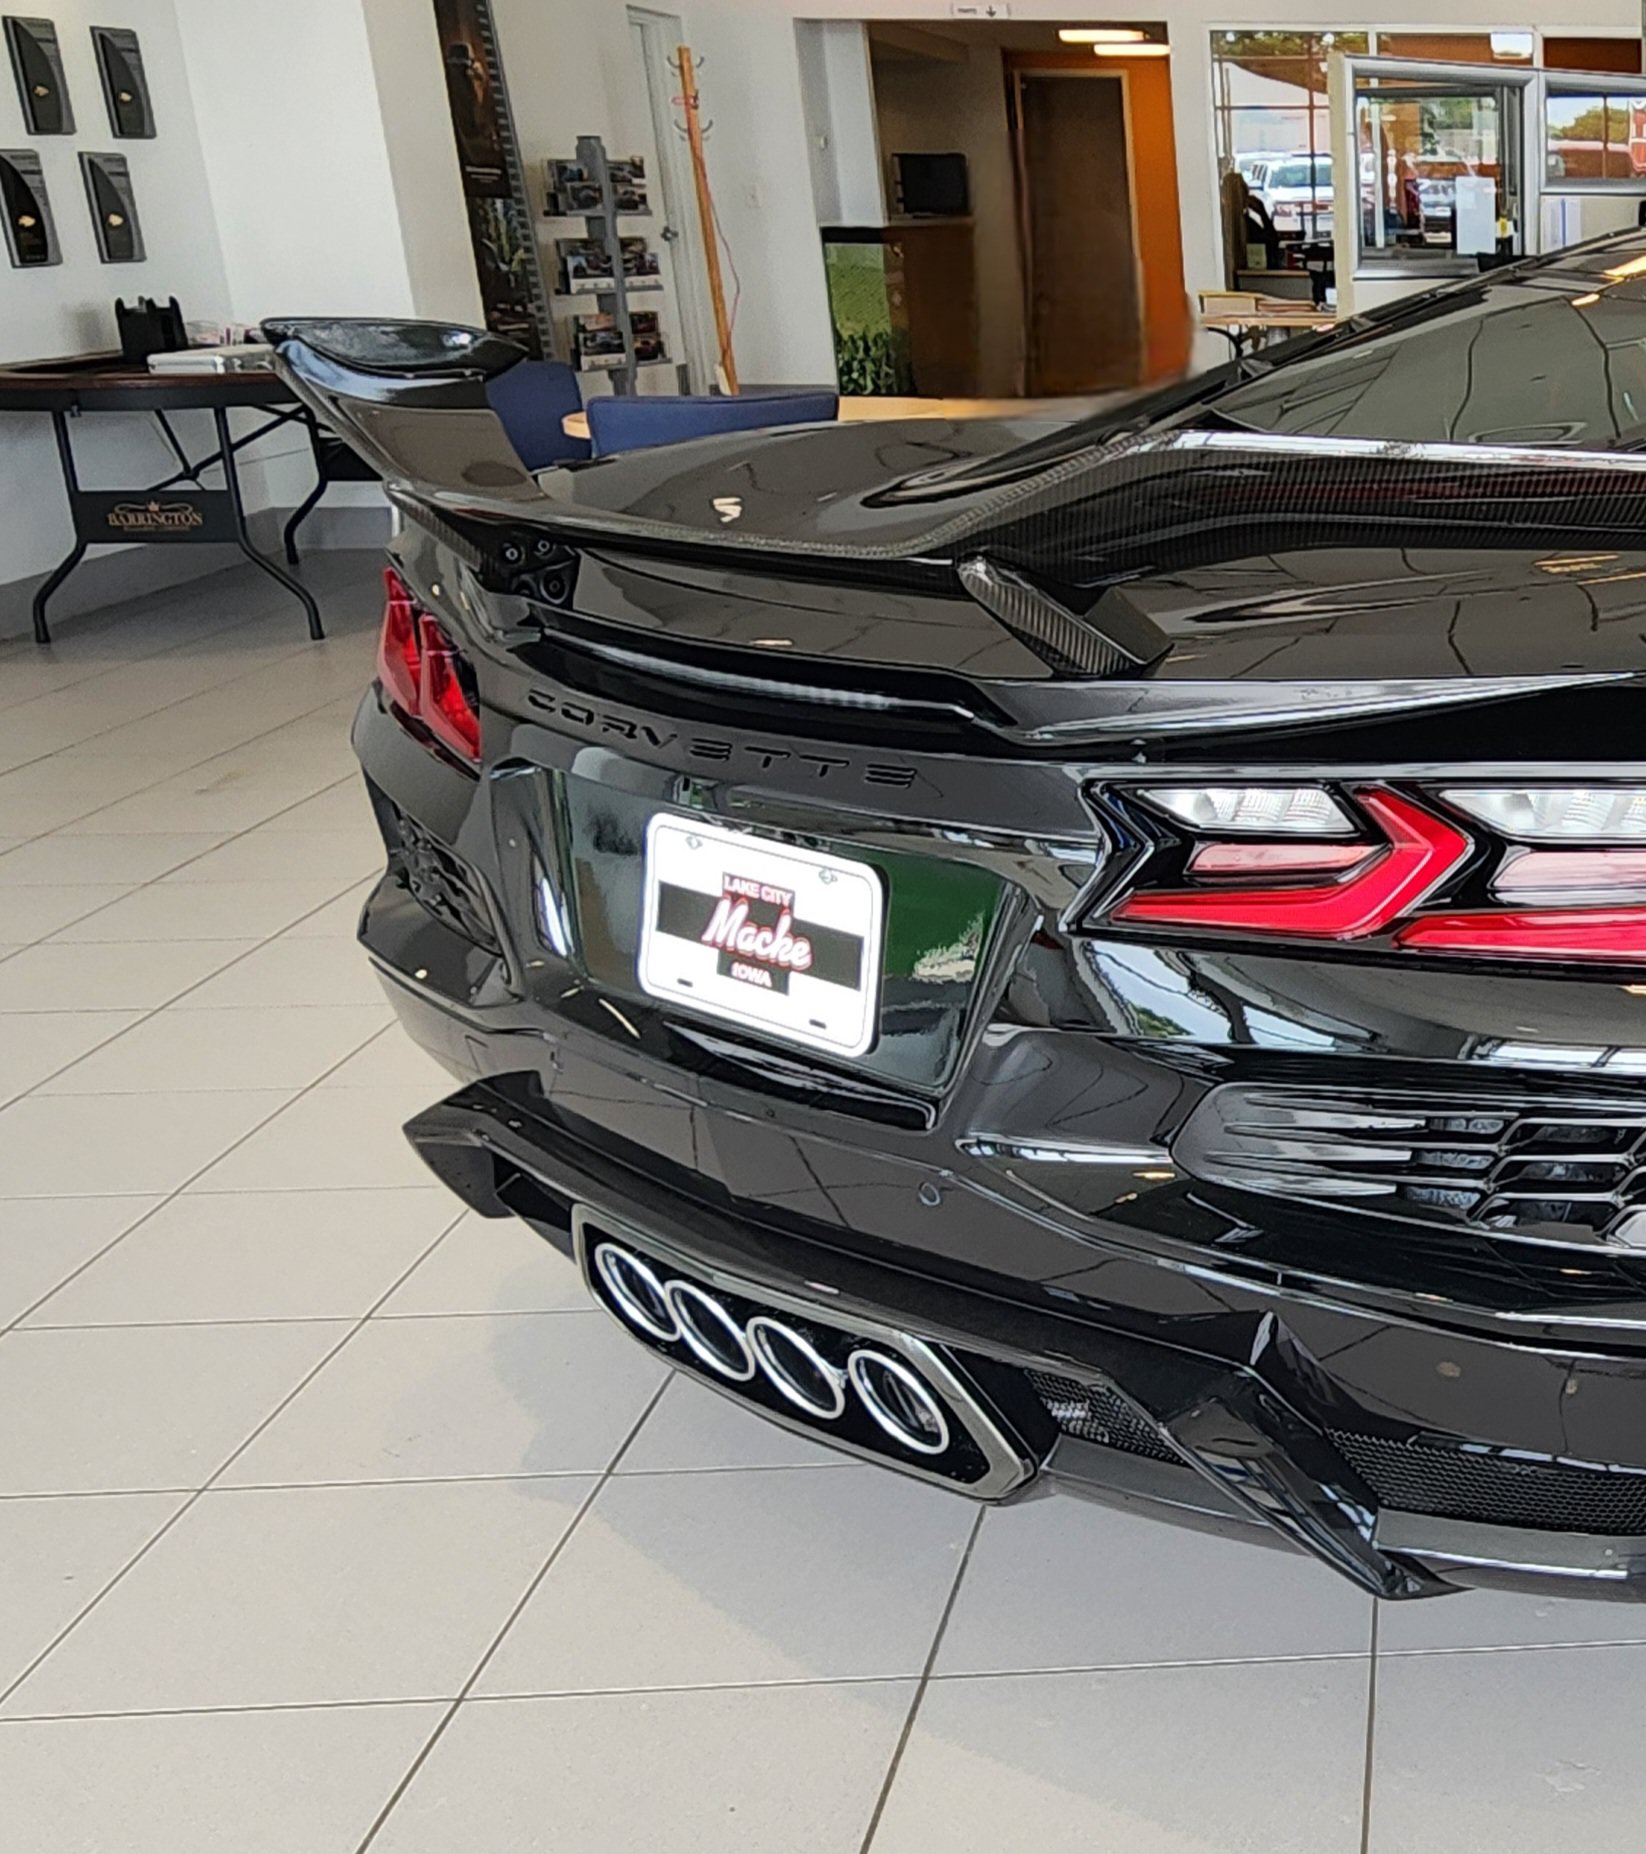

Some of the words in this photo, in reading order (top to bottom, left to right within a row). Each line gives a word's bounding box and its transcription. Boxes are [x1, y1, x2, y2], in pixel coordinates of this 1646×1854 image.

[107, 512, 203, 526] BARRINGTON
[528, 689, 919, 788] CORVETTE
[723, 875, 760, 899] LAKE
[761, 885, 793, 908] CITY
[701, 894, 813, 971] Macke
[731, 961, 773, 988] IOWA
